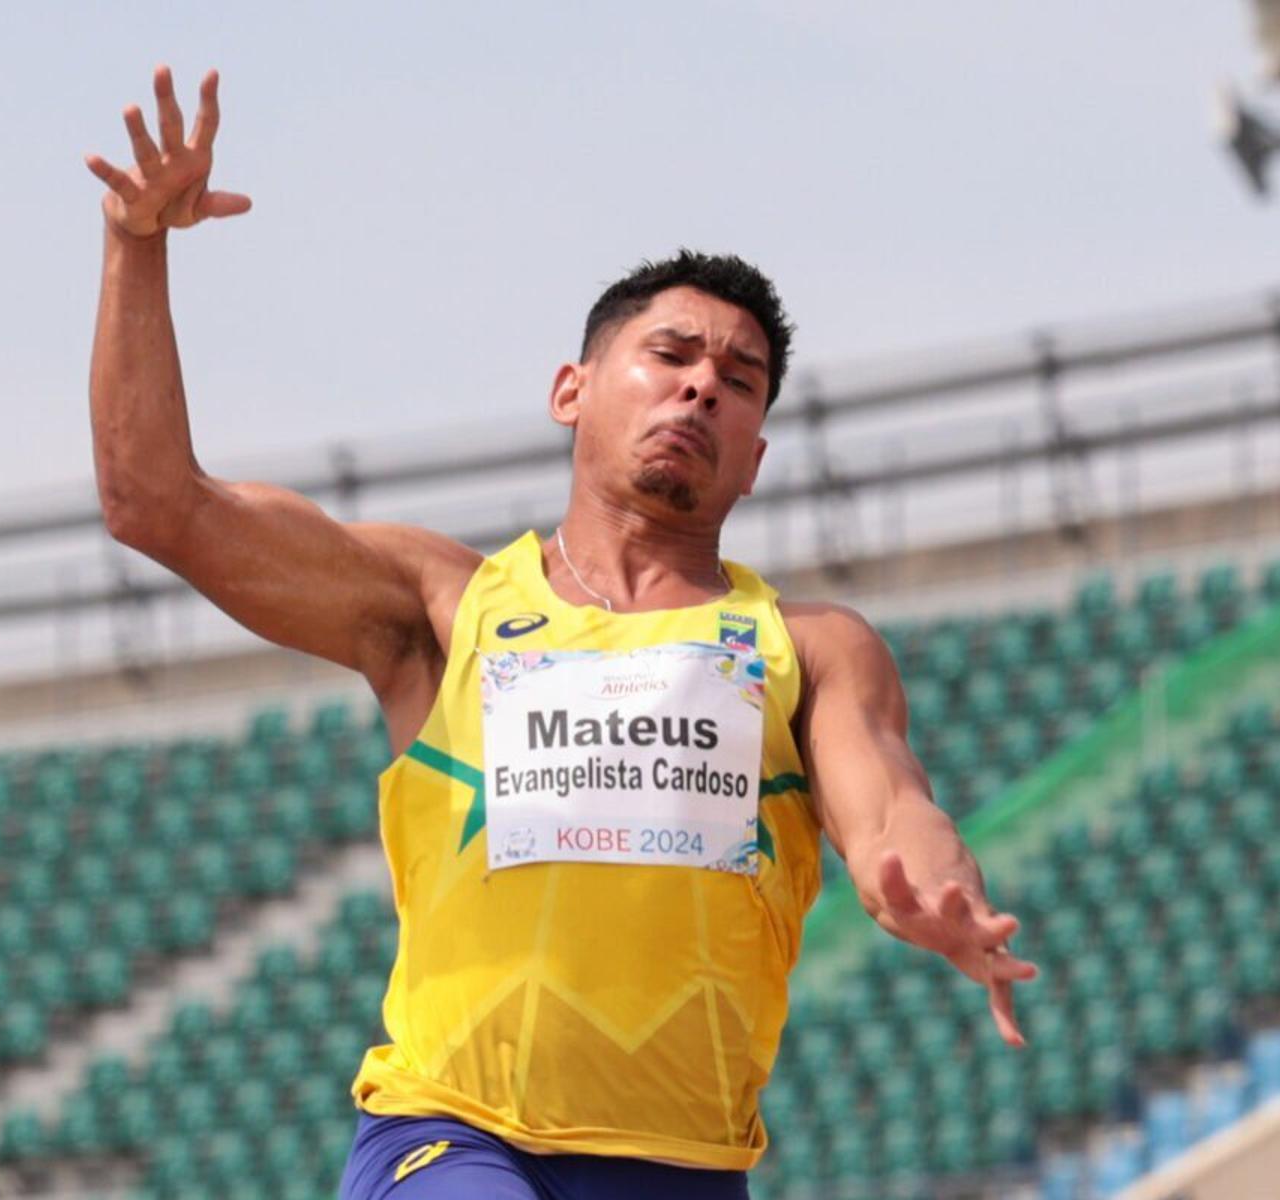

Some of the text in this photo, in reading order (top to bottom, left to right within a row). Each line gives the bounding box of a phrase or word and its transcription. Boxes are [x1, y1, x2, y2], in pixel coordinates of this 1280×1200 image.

[527, 709, 719, 751] Mateus
[495, 757, 749, 799] Evangelista Cardoso
[556, 827, 705, 856] KOBE 2024
